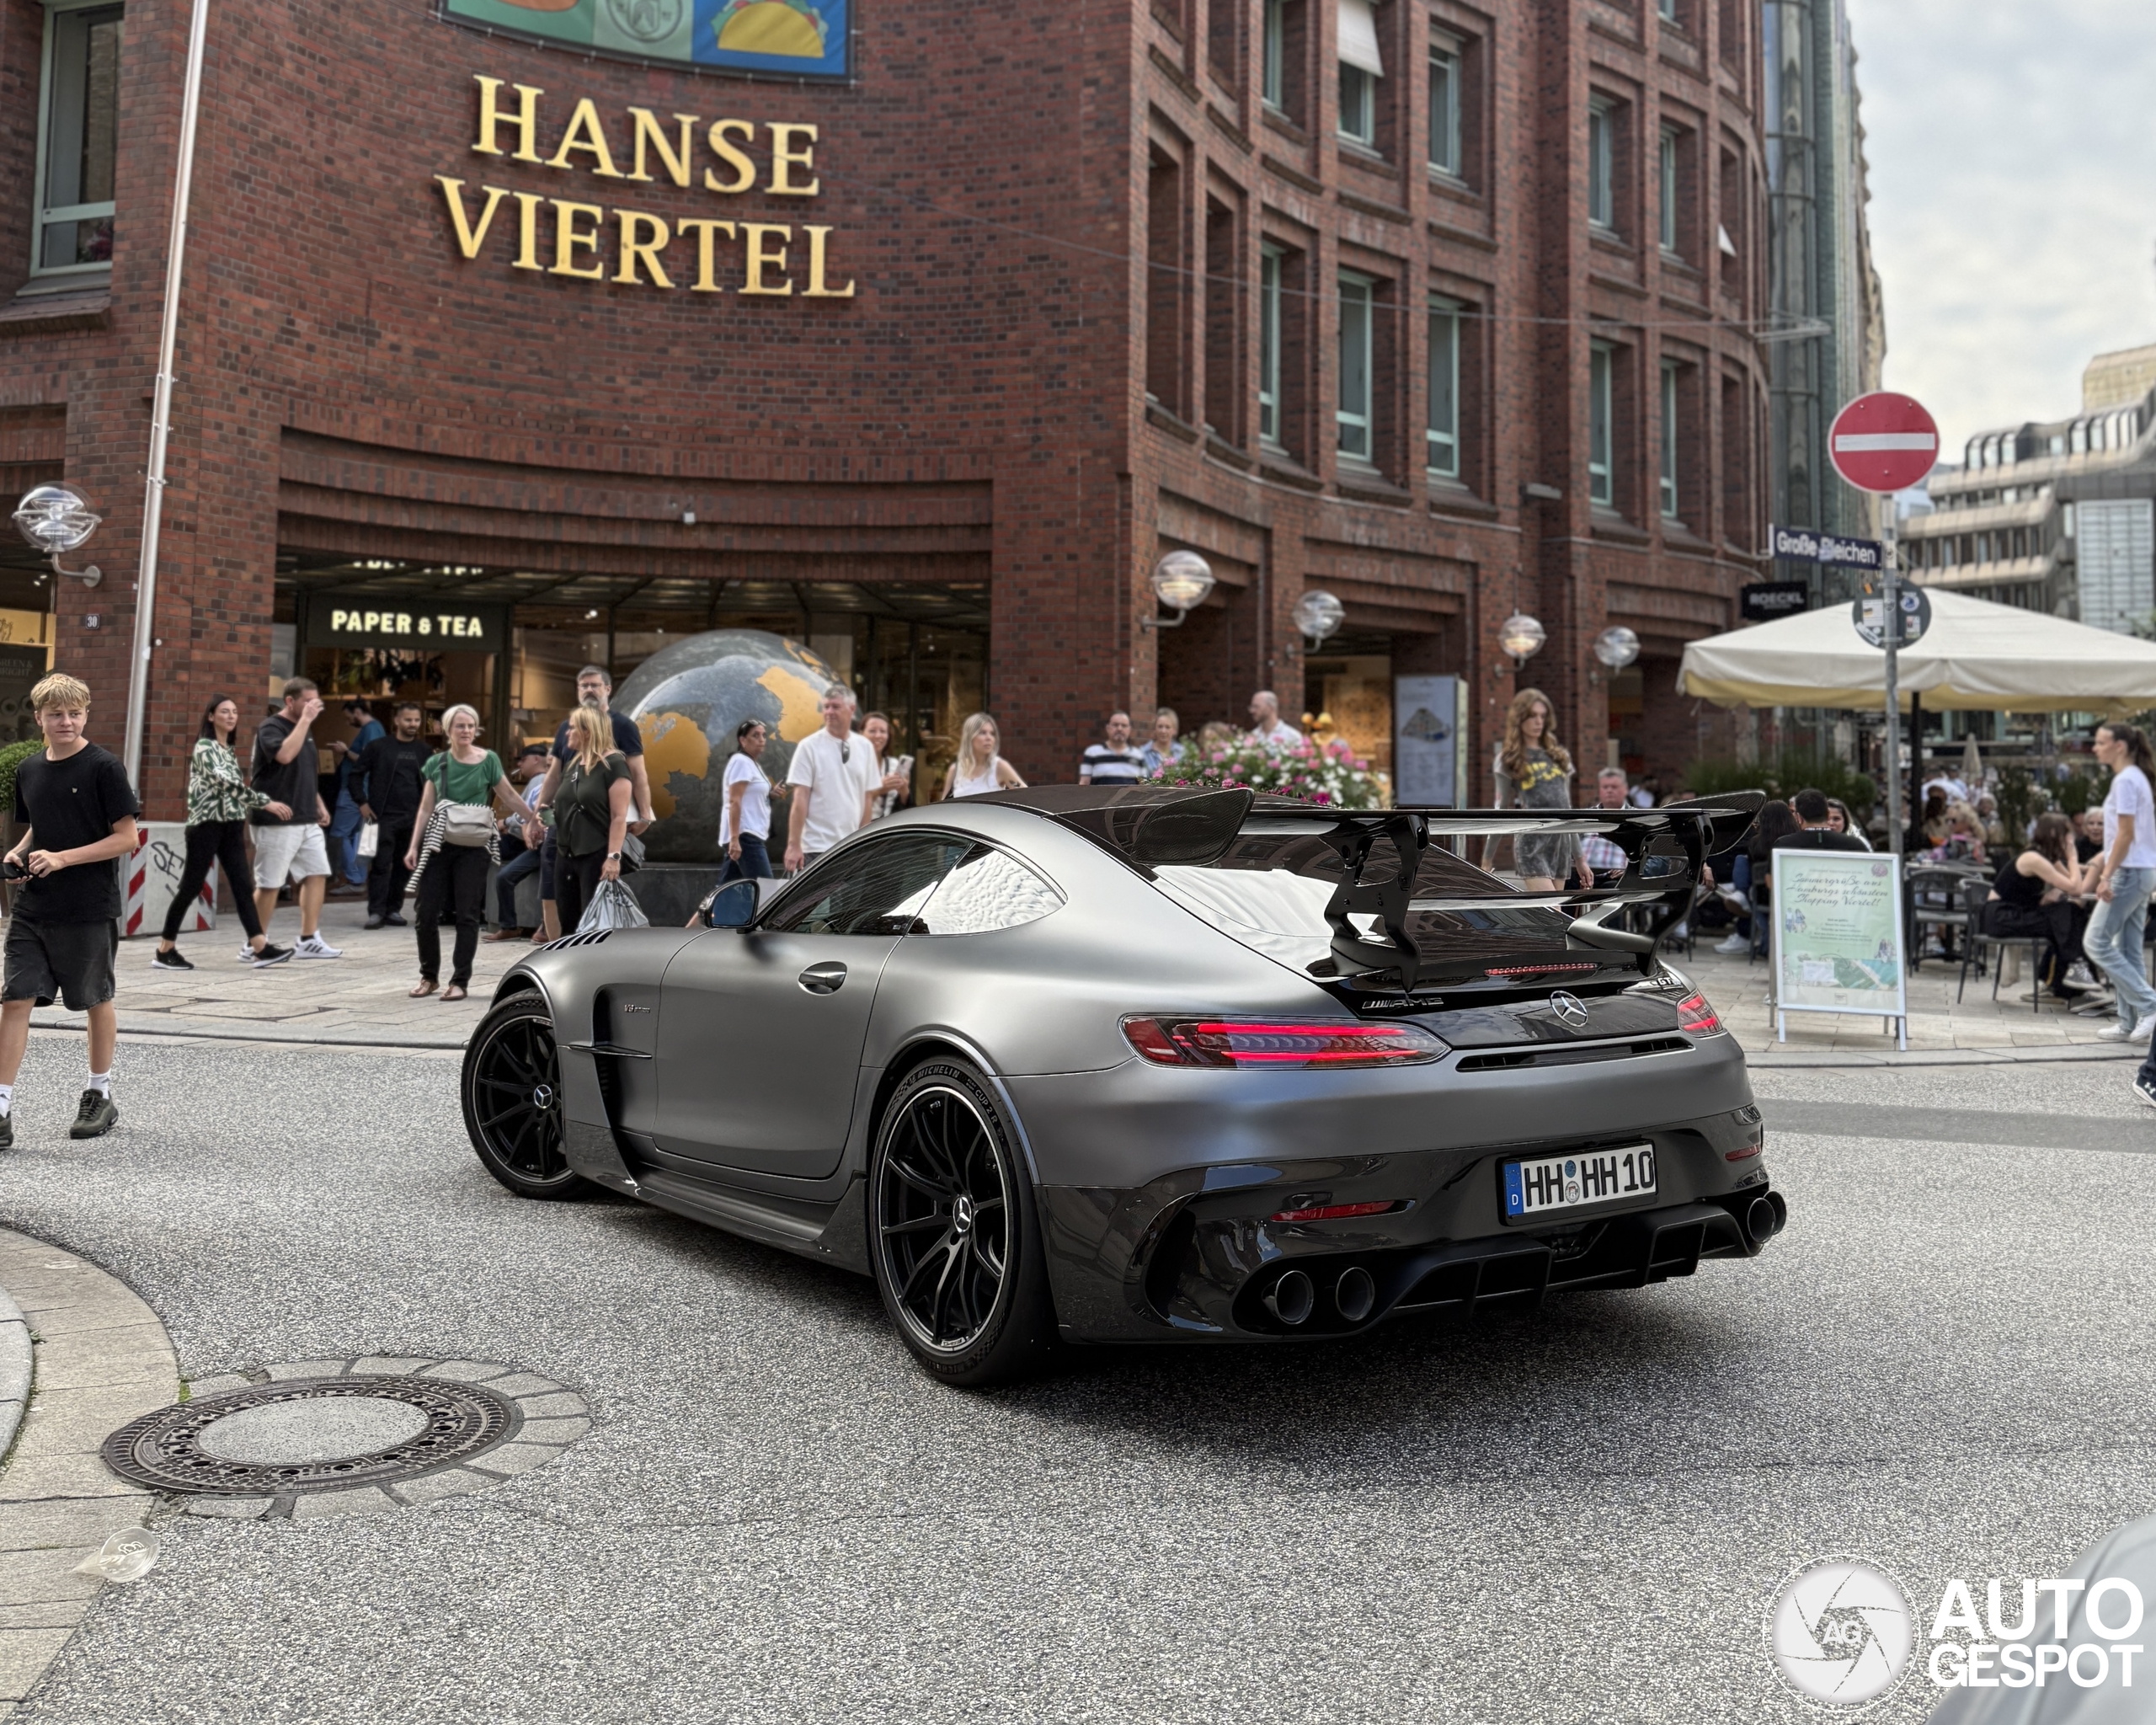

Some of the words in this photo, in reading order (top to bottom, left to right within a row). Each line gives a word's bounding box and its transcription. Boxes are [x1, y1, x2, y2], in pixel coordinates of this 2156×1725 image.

[472, 74, 819, 196] HANSE
[434, 174, 855, 298] VIERTEL
[1776, 531, 1817, 557] Große
[1748, 592, 1804, 606] ROECKL
[87, 616, 98, 628] 30
[331, 610, 412, 634] PAPER
[418, 617, 431, 634] &
[437, 615, 483, 638] TEA
[1791, 873, 1860, 887] Sommergrüße
[1785, 884, 1838, 896] Hamburgs
[1843, 885, 1888, 897] schönstem
[1794, 894, 1838, 907] Shopping
[1842, 895, 1881, 907] Viertel!
[1389, 997, 1444, 1007] AMG
[916, 1065, 961, 1080] MICHELIN
[974, 1089, 989, 1106] CUP
[990, 1115, 998, 1124] R
[1524, 1163, 1565, 1207] HH
[1580, 1156, 1619, 1199] HH
[1623, 1151, 1655, 1192] 10
[1511, 1194, 1518, 1205] D
